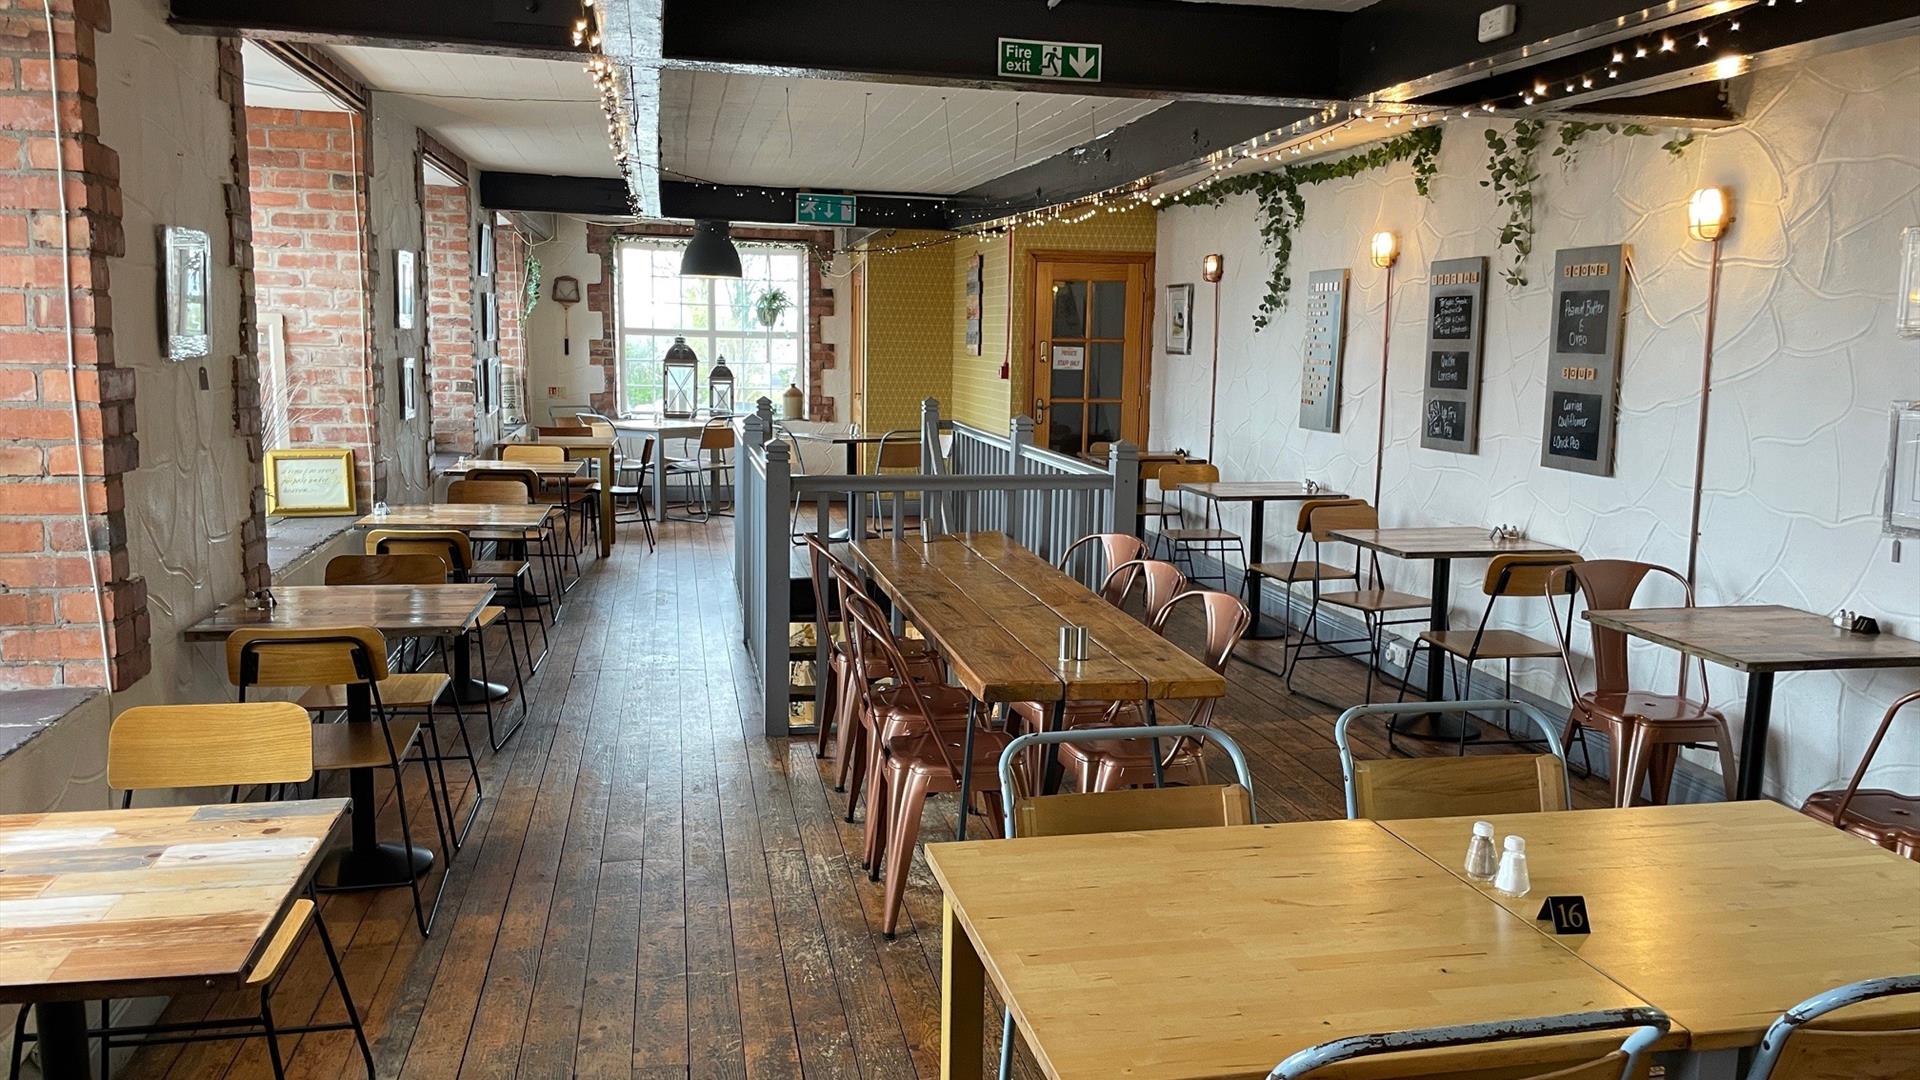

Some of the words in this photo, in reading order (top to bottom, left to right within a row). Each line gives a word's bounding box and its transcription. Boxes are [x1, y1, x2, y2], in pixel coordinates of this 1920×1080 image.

[1006, 44, 1032, 59] Fire
[1006, 60, 1031, 72] exit
[1565, 264, 1606, 277] SCONE
[1432, 272, 1477, 285] SPECIAL
[1565, 299, 1585, 318] Peanut
[1585, 300, 1604, 317] Butter
[1569, 332, 1588, 346] Oreo
[1563, 368, 1594, 379] SOUP
[1557, 903, 1583, 928] 16
